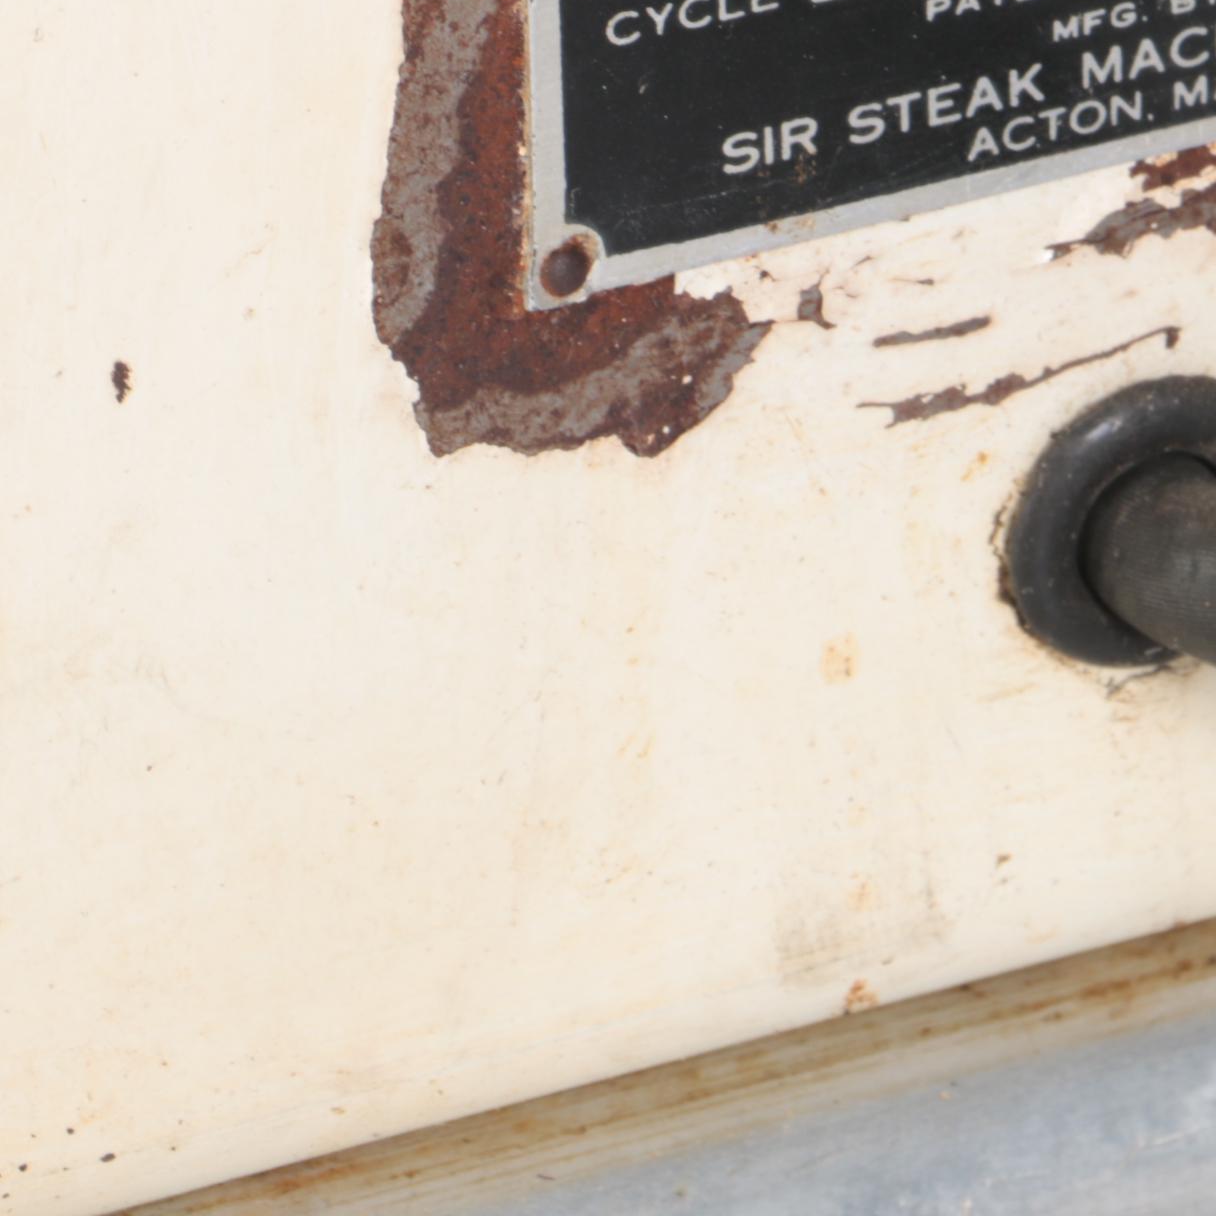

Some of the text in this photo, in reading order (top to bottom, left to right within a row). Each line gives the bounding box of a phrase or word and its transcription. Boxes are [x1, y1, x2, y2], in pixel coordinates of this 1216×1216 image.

[1052, 1, 1150, 44] MFG.
[721, 117, 819, 175] SIR
[848, 62, 1046, 145] STEAK
